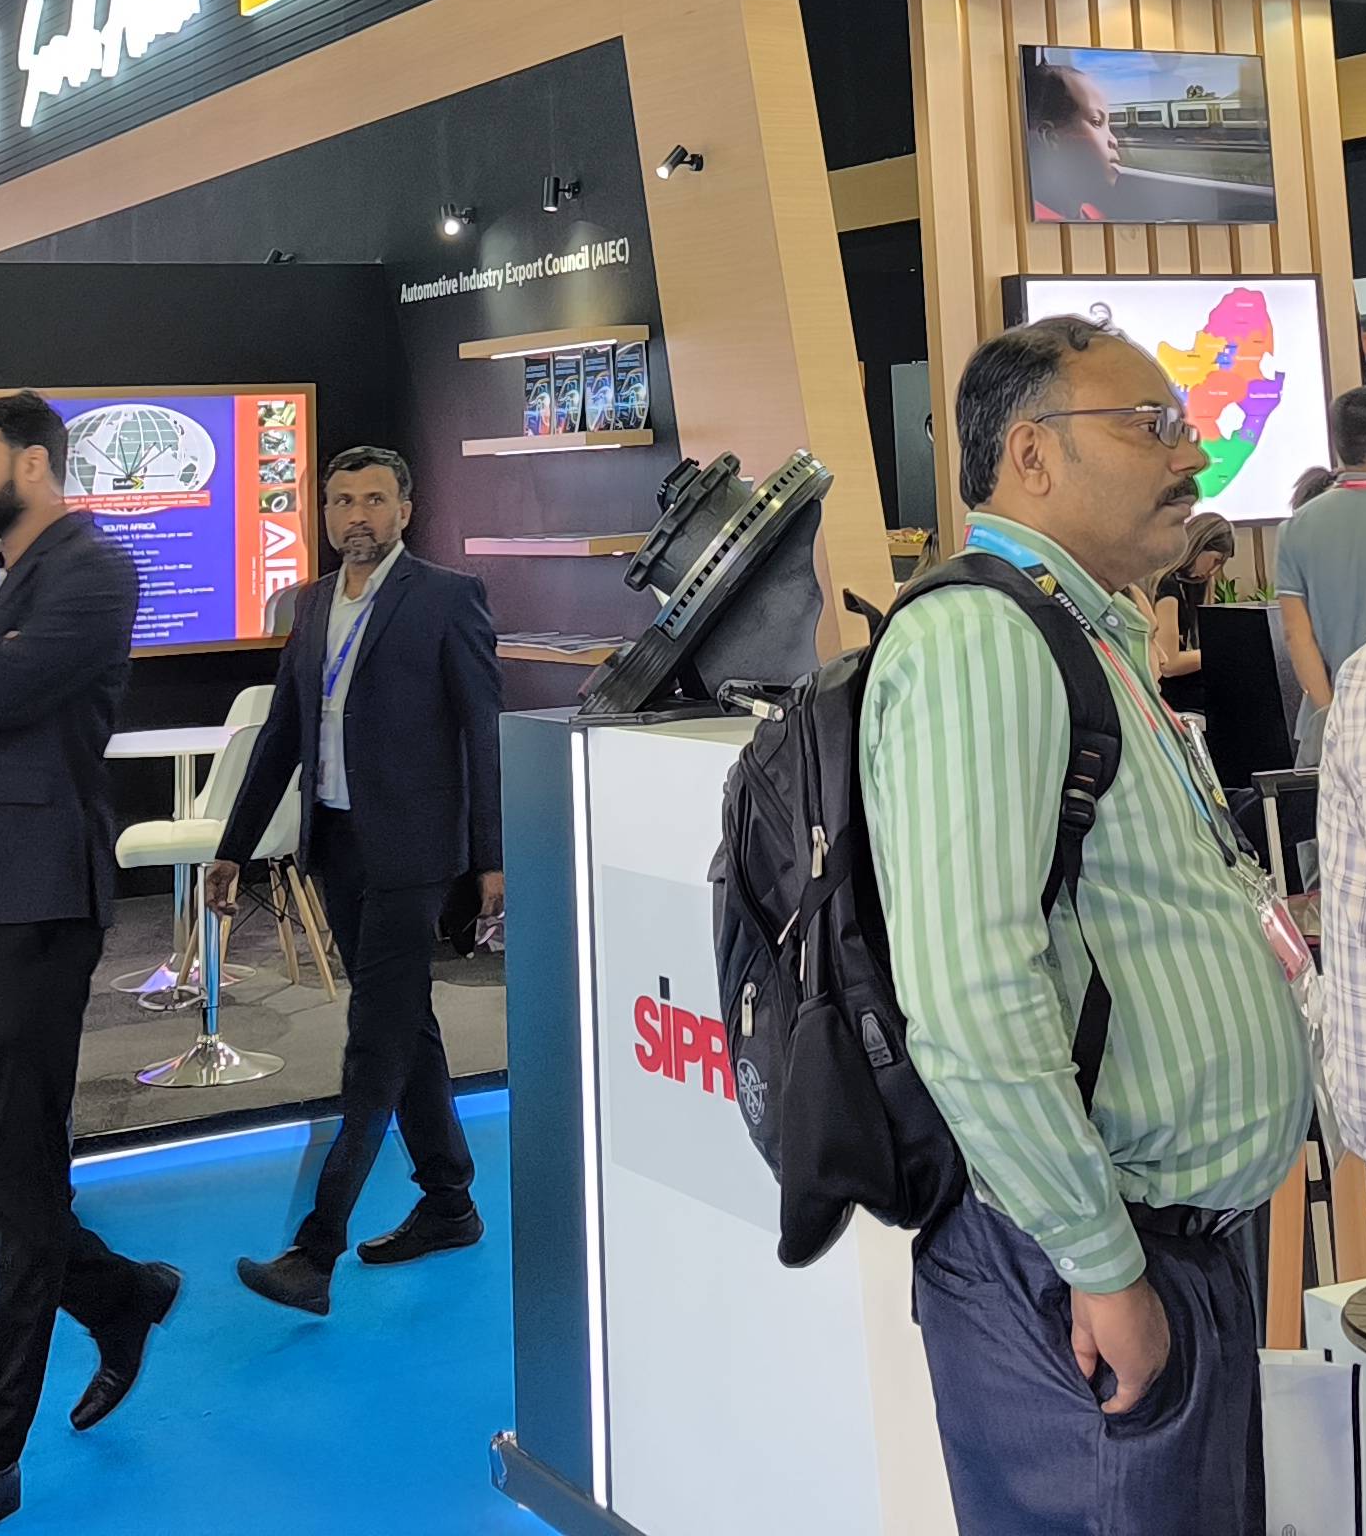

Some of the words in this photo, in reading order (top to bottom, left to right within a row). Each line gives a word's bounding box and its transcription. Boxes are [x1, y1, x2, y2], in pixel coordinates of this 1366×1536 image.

[401, 274, 458, 303] Automotive
[459, 266, 503, 291] Industry
[506, 257, 543, 286] Export
[545, 245, 589, 276] Council
[592, 237, 629, 269] (AIEC)
[265, 520, 297, 602] AIE
[635, 975, 736, 1103] SiPR
